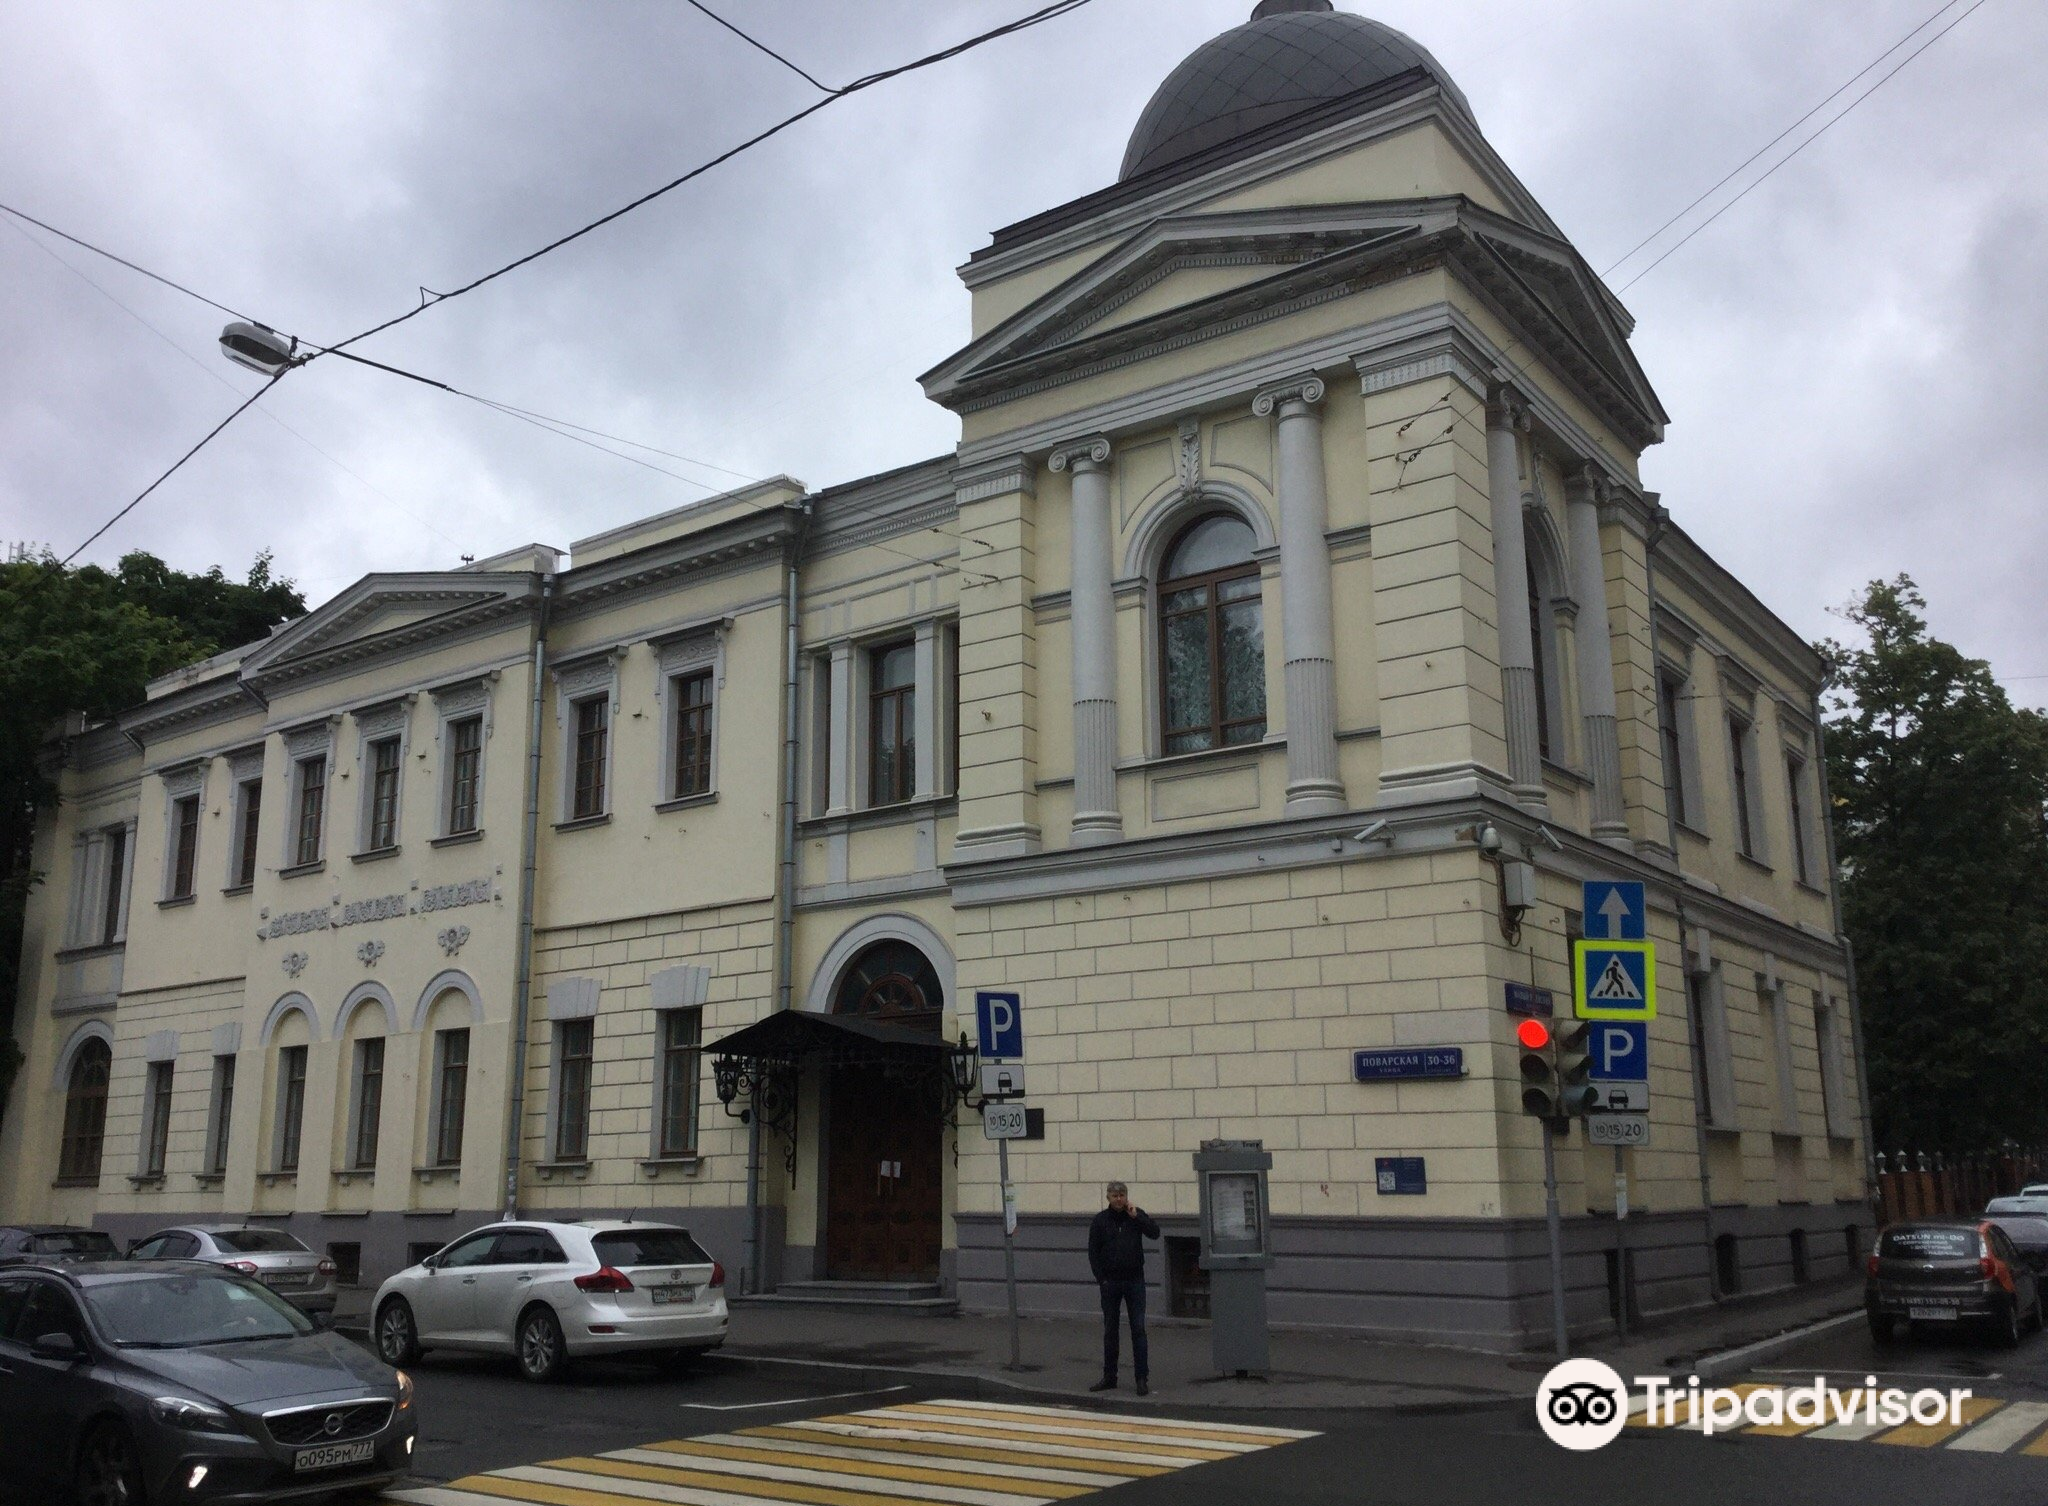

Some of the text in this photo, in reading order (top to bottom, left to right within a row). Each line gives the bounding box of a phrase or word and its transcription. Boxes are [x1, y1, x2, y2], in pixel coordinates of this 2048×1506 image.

[988, 999, 1014, 1051] P
[1603, 1028, 1634, 1072] P
[1362, 1056, 1419, 1067] ПОВАРСКАЯ
[989, 1113, 1021, 1127] 10 15 20
[1595, 1124, 1641, 1136] 10 15 20
